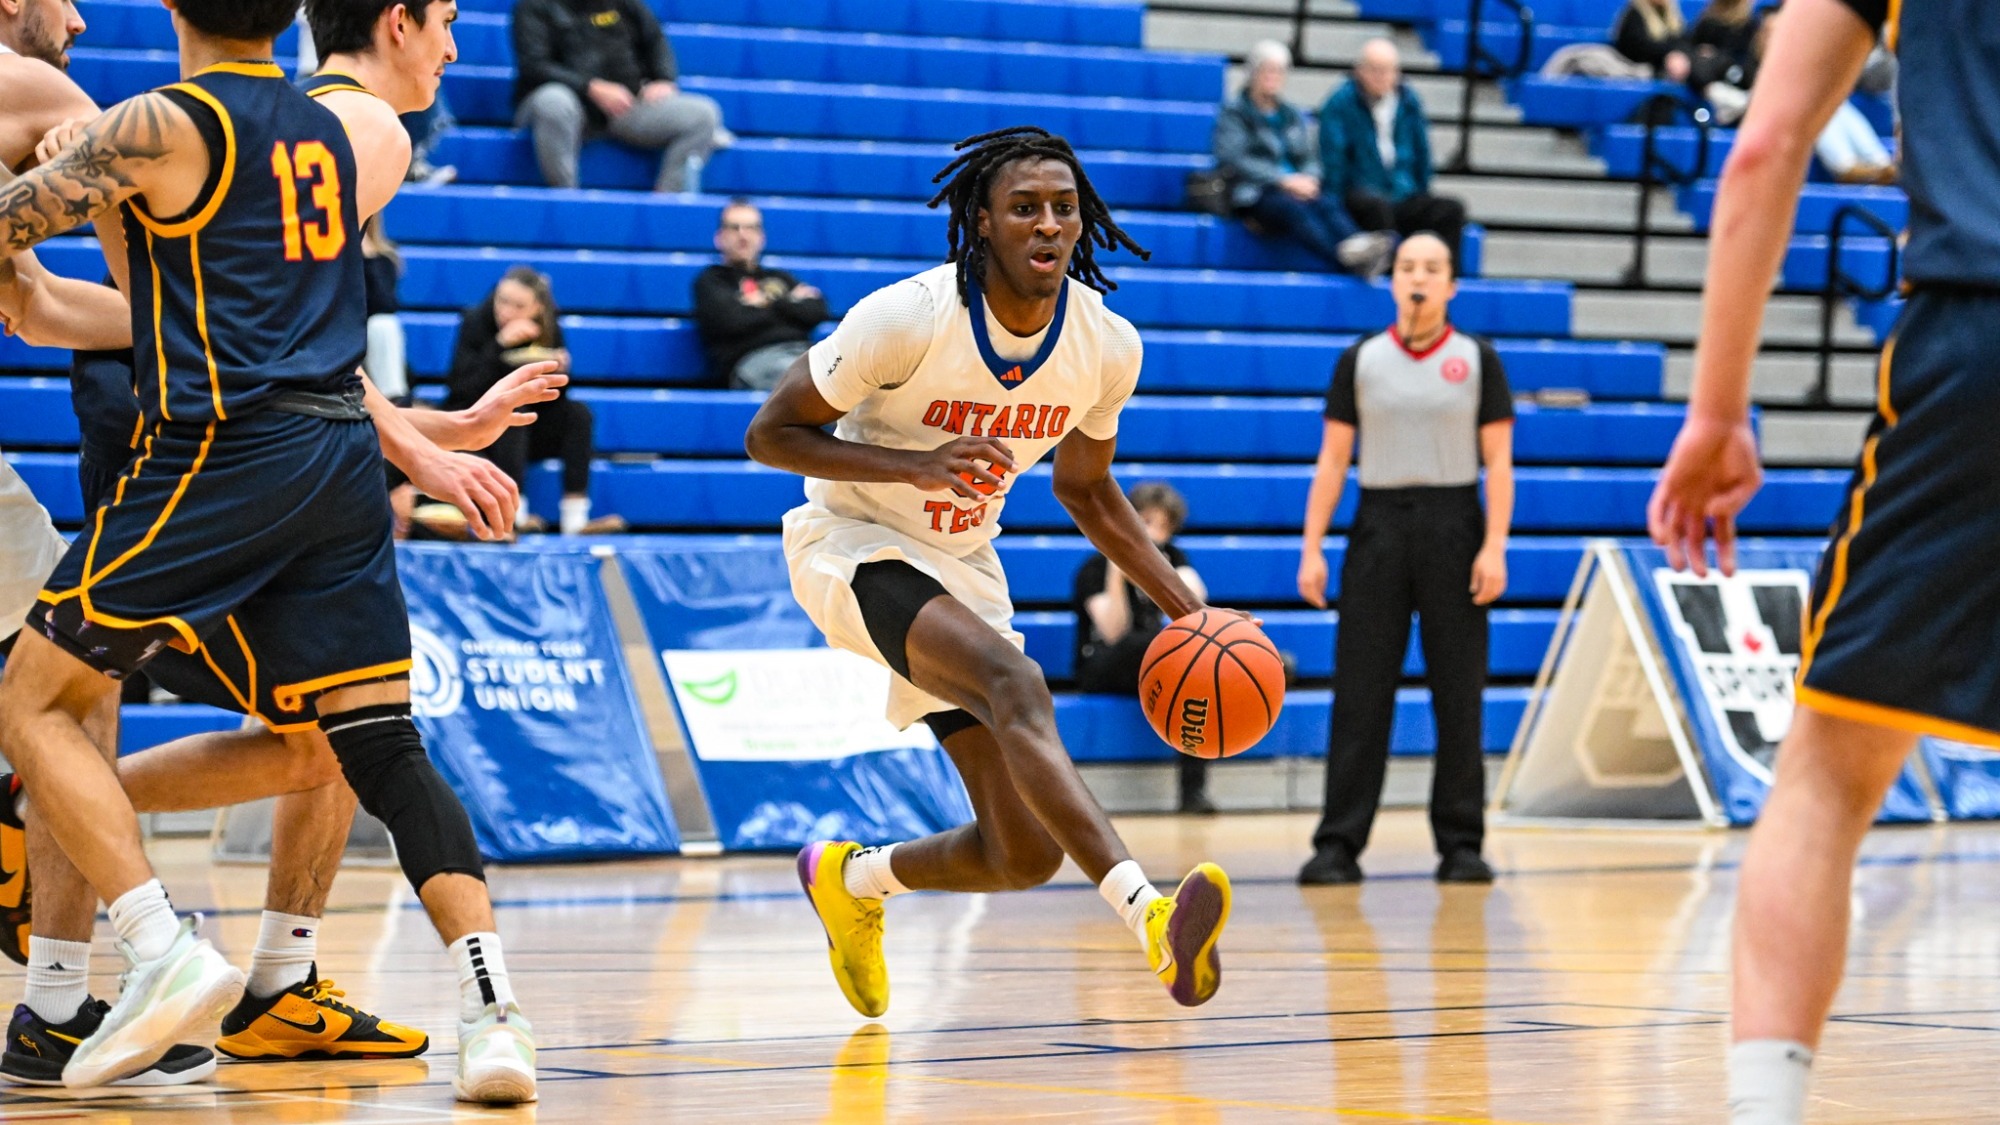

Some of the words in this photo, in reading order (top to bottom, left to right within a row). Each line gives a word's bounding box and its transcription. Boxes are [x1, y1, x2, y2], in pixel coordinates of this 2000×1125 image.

[270, 139, 346, 261] 13
[922, 400, 1070, 439] ONTARIO
[465, 657, 604, 685] STUDENT
[473, 684, 578, 711] UNION
